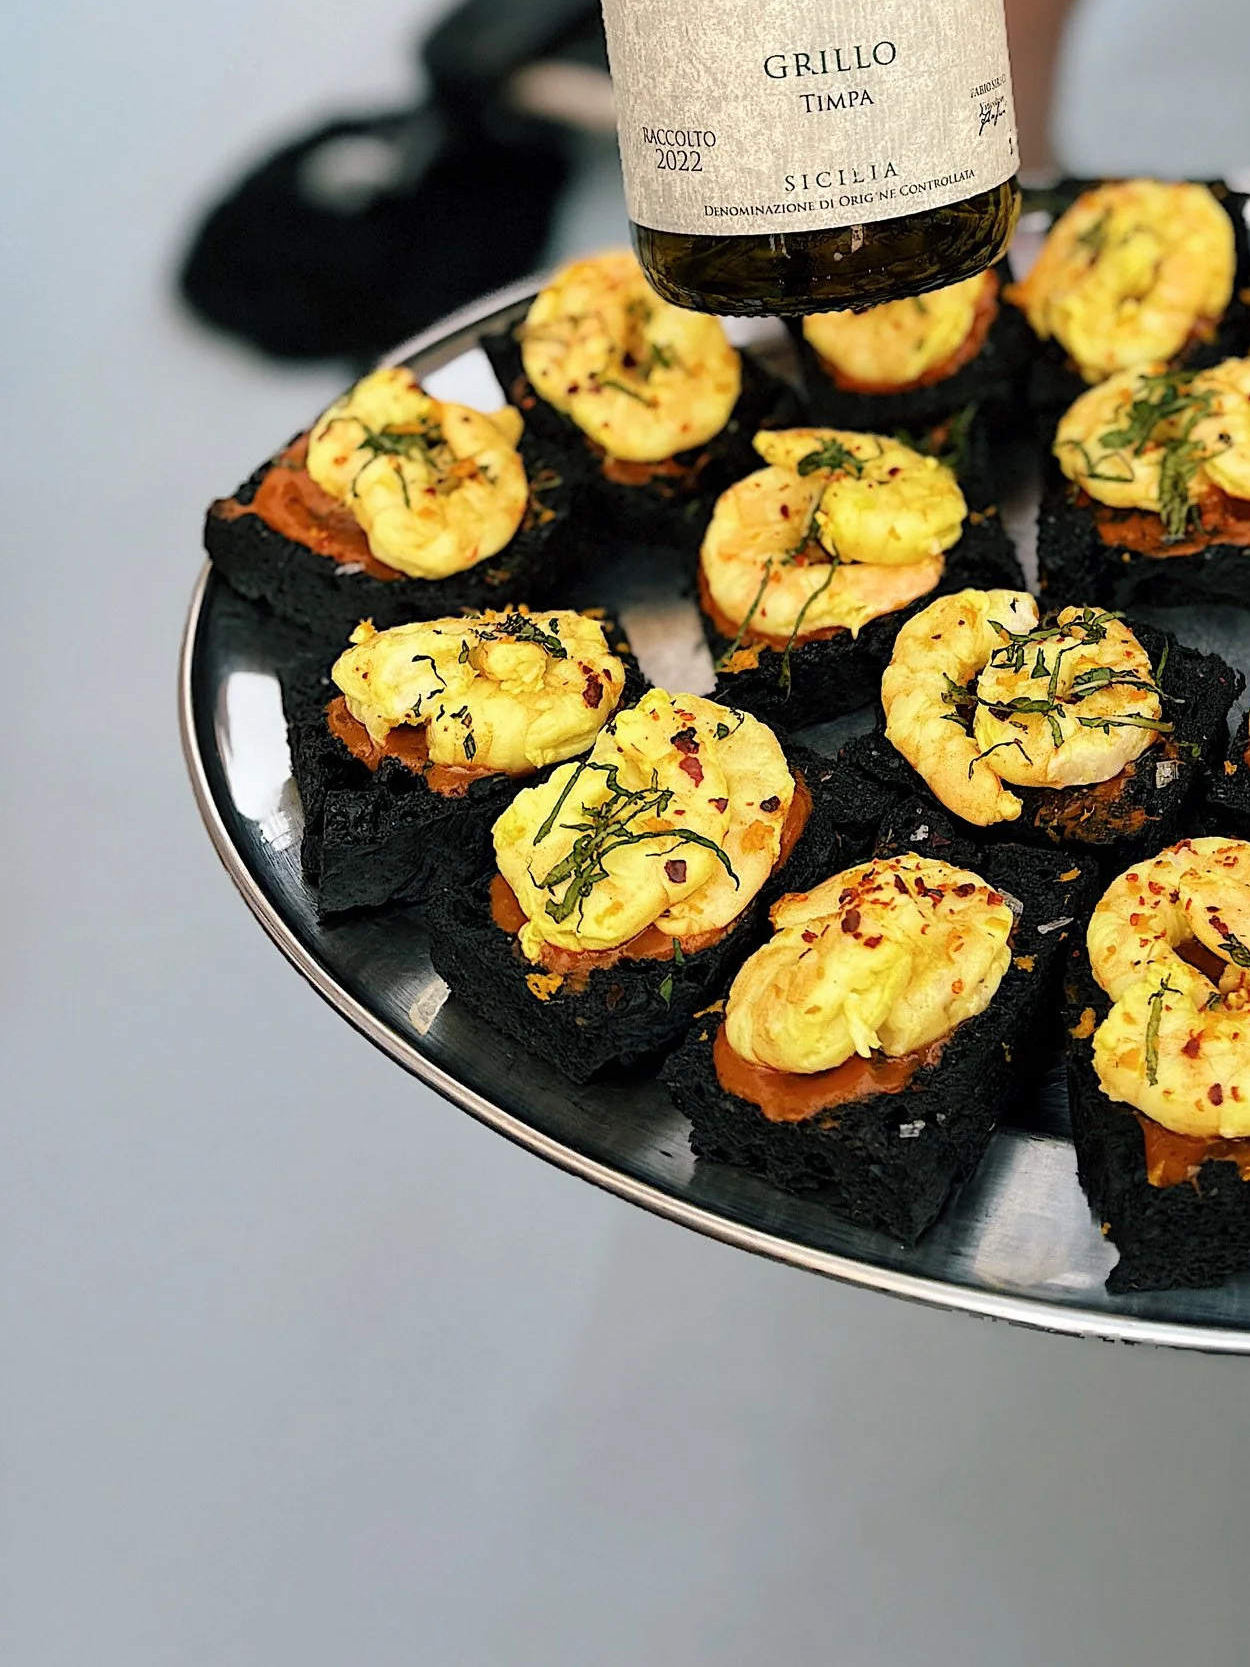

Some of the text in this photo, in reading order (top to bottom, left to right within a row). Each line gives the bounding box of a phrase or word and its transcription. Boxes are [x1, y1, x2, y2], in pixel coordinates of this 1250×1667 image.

[763, 41, 897, 79] GRILLO
[799, 89, 875, 113] TIMPA
[642, 126, 717, 148] RACCOLTO
[655, 148, 703, 172] 2022
[784, 162, 899, 192] SICILIA
[704, 168, 976, 217] DENOMINAZIONE DI ORIGNE CONTROLLATA
